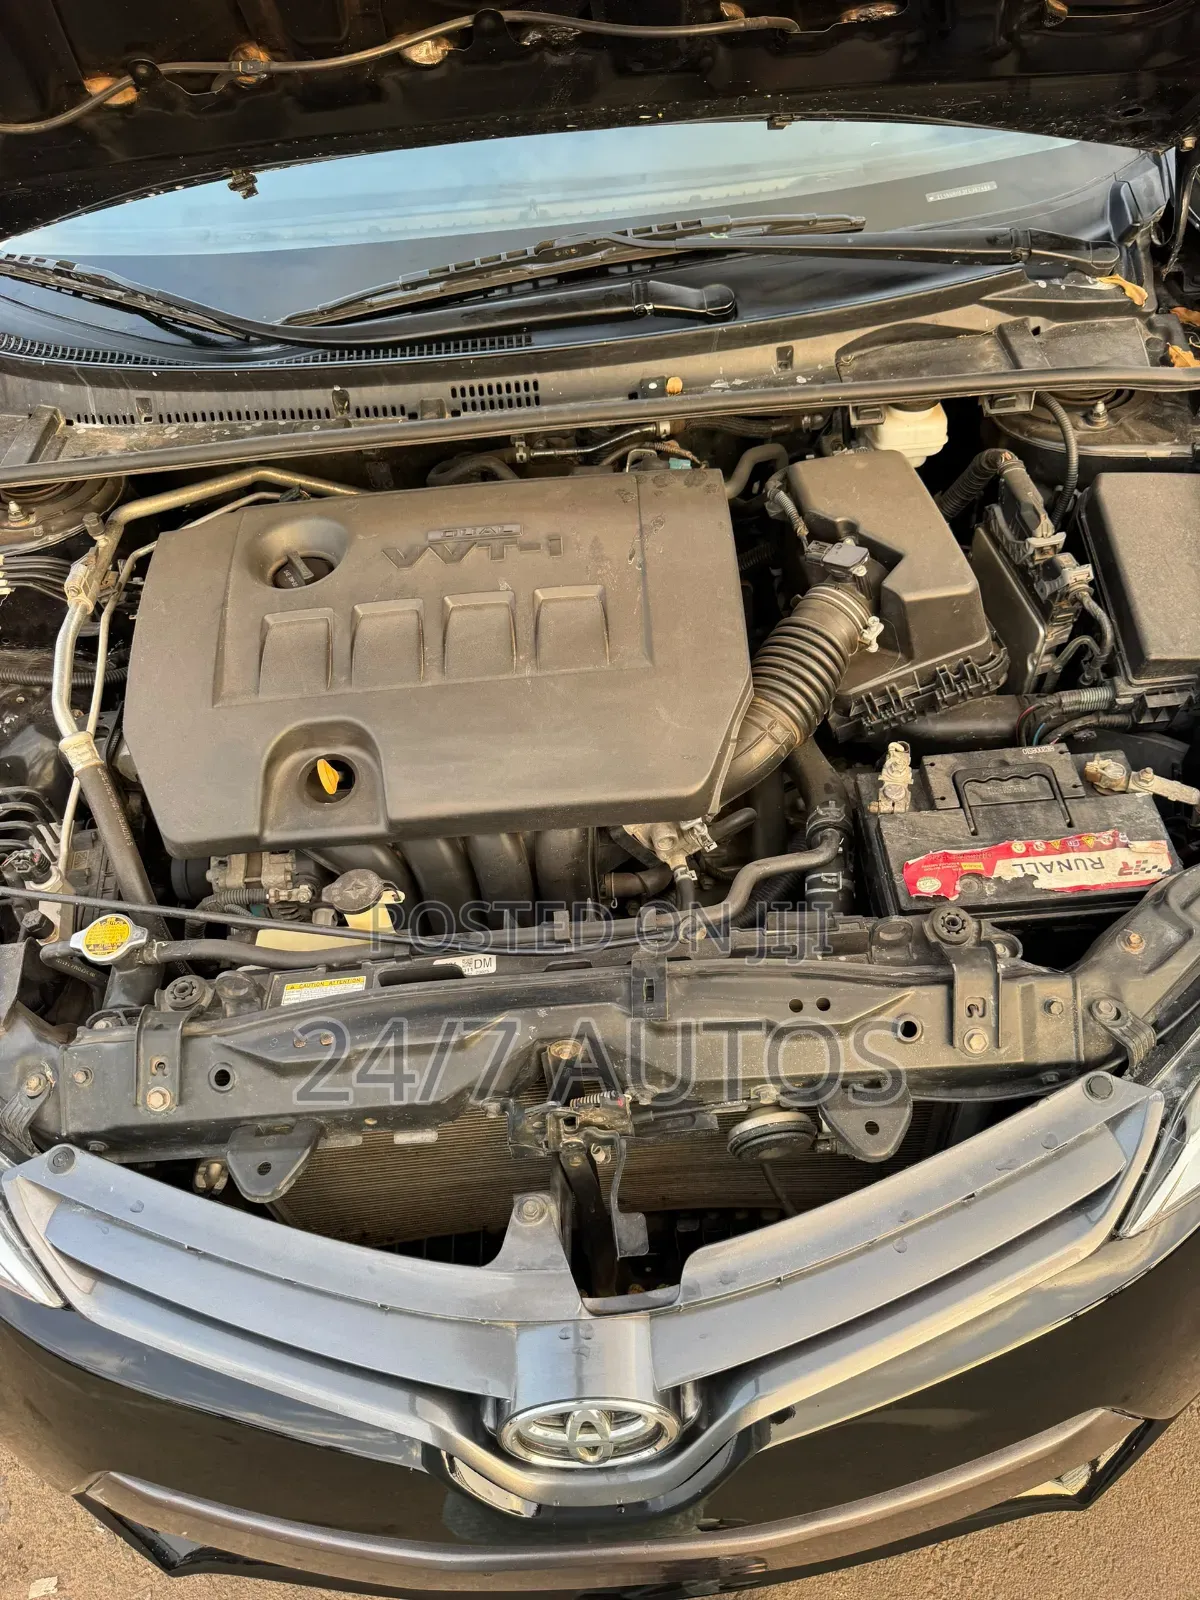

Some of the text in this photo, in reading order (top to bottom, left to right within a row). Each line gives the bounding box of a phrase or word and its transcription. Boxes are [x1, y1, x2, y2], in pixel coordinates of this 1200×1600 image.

[1012, 857, 1105, 874] RUNALL
[474, 957, 492, 970] DM
[299, 977, 361, 989] CAUTION ATTENTION
